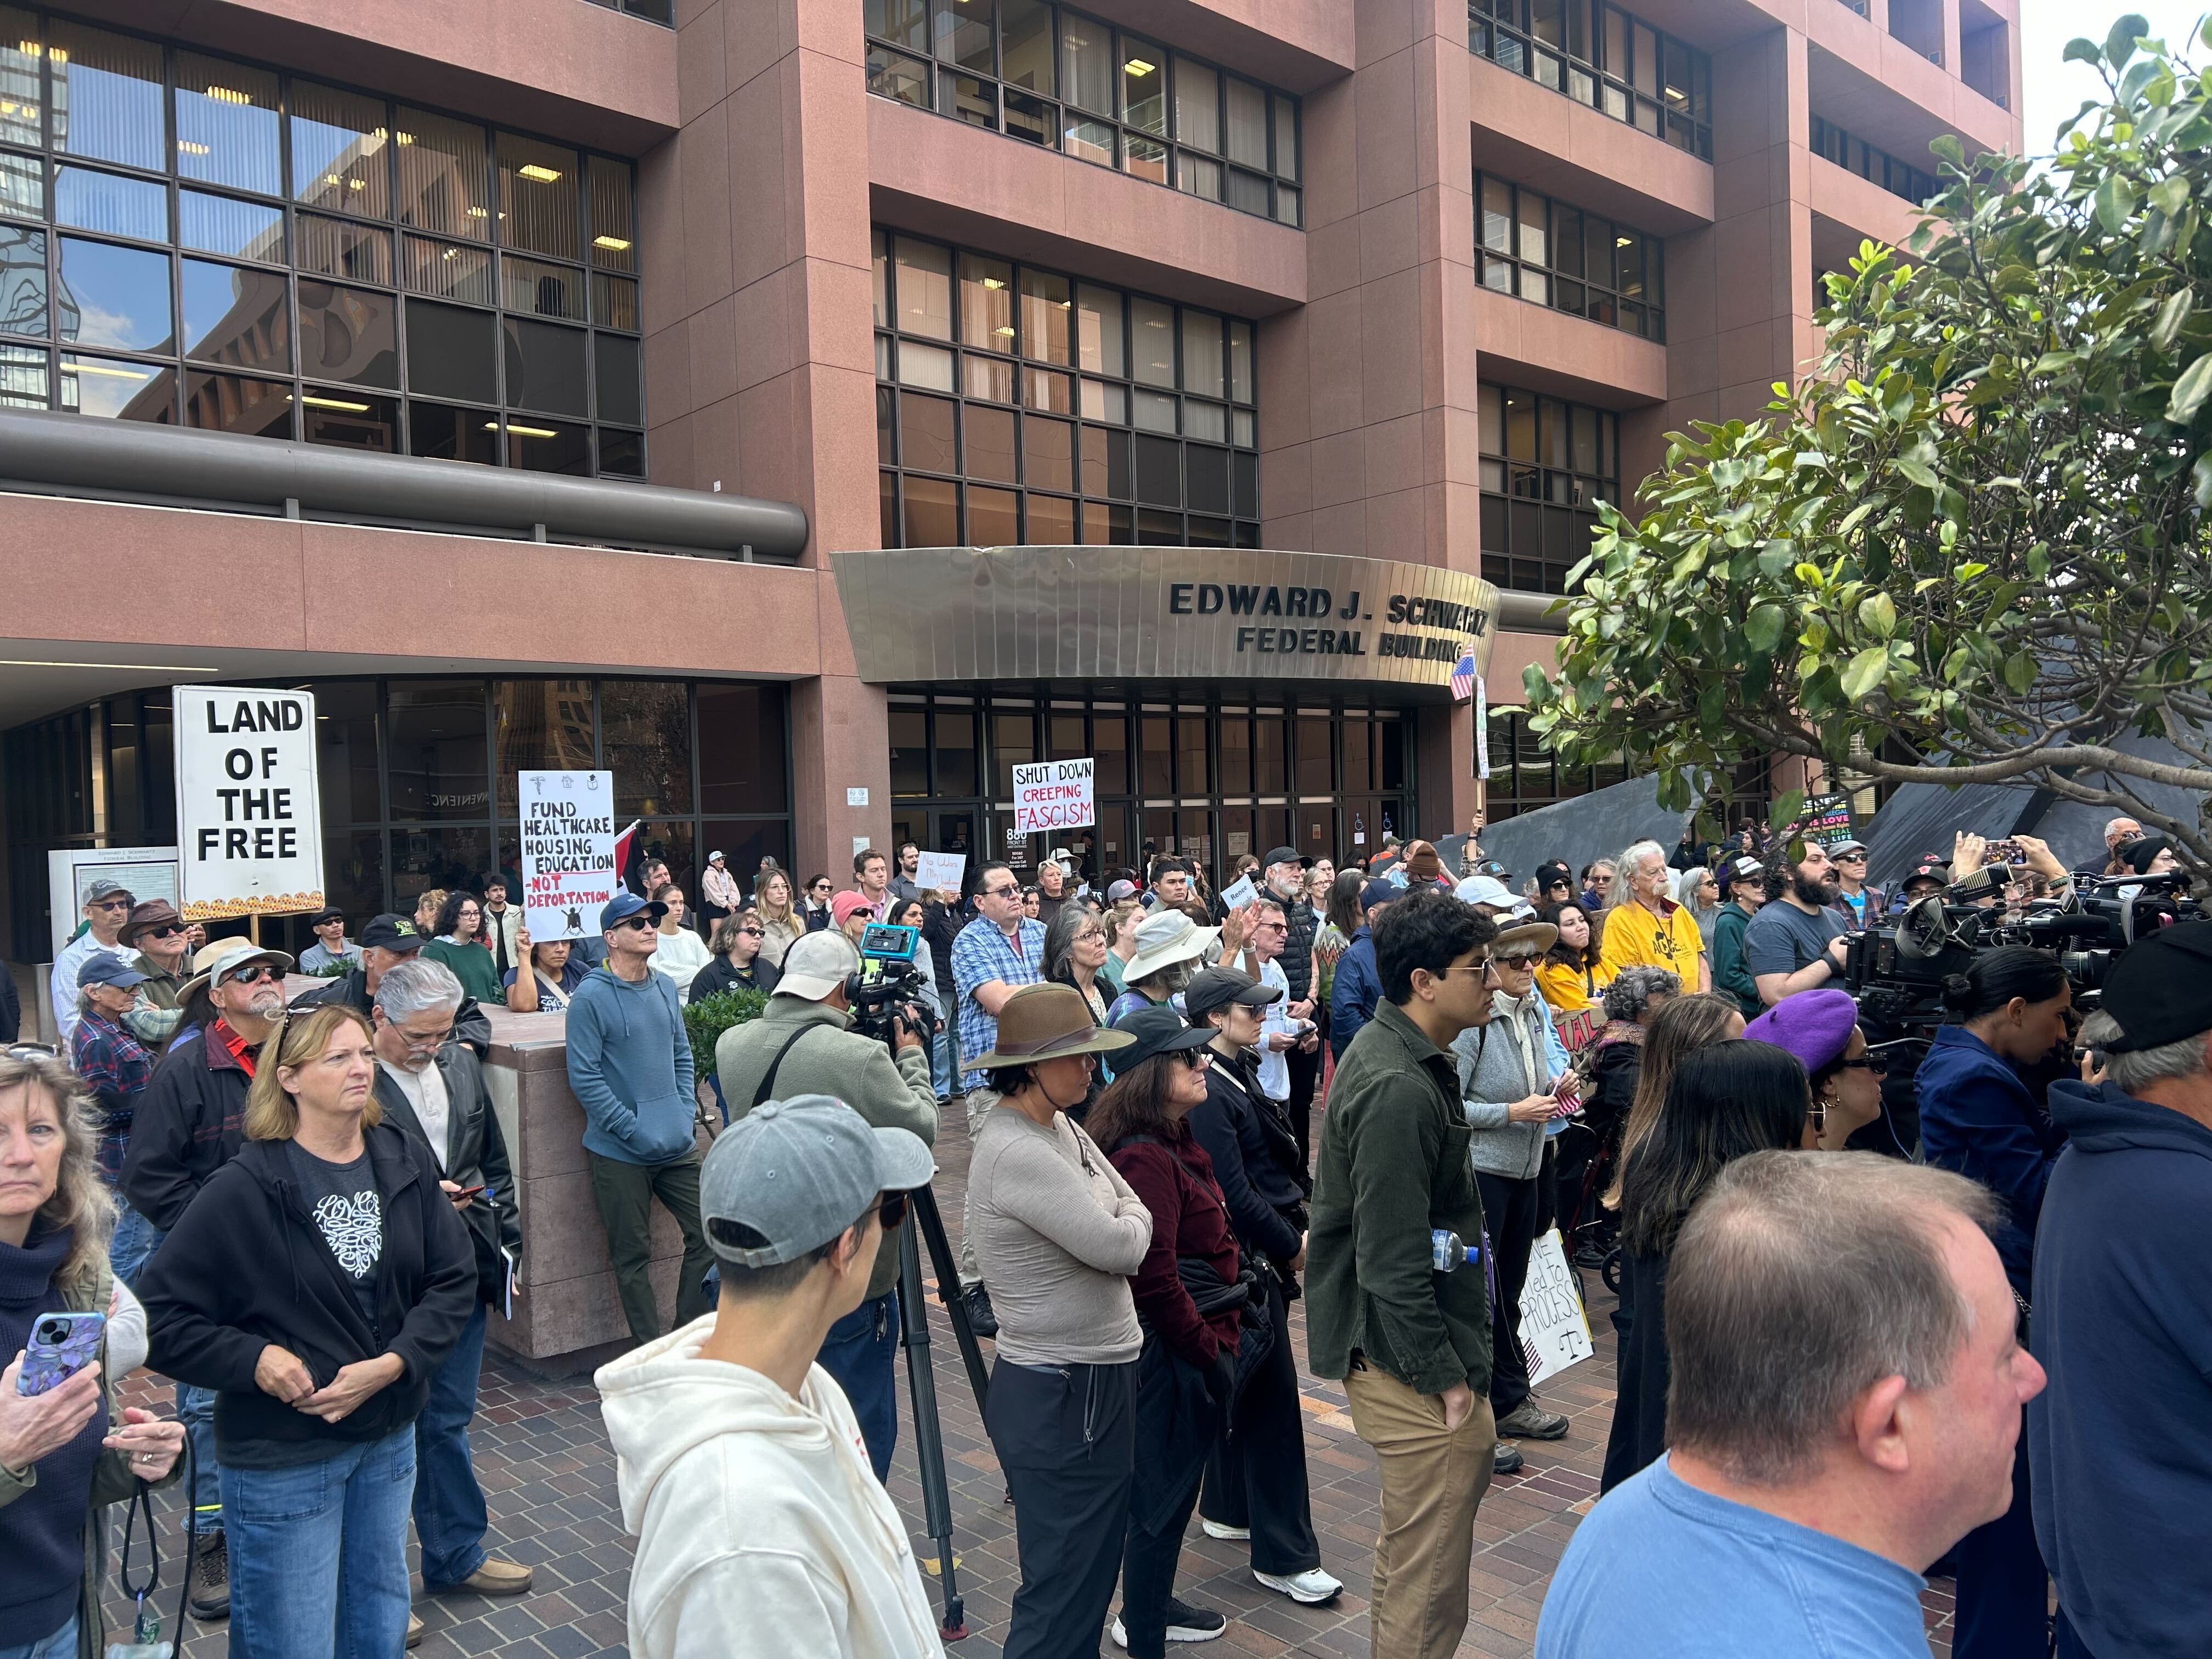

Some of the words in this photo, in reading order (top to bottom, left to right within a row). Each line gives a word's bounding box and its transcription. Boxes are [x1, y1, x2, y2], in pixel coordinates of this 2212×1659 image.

[1170, 583, 1331, 617] EDWARD
[1341, 591, 1372, 620] J.
[1237, 627, 1365, 655] FEDERAL
[1378, 633, 1463, 664] BUILDING
[206, 700, 302, 733] LAND
[225, 747, 278, 781] OF
[1016, 766, 1049, 785] SHUT
[1059, 762, 1091, 780] DOWN
[217, 788, 292, 821] THE
[1023, 784, 1081, 803] CREEPING
[531, 802, 576, 817] FUND
[1018, 801, 1092, 831] FASCISM
[1822, 815, 1849, 825] LOVE
[198, 827, 297, 861] FREE
[1006, 828, 1027, 840] 880
[535, 854, 614, 874] EDUCATION
[923, 854, 934, 866] No
[528, 890, 610, 908] DEPORTATION
[1230, 885, 1248, 900] Renee
[1546, 1258, 1564, 1285] to
[1519, 1280, 1580, 1336] PROCESS
